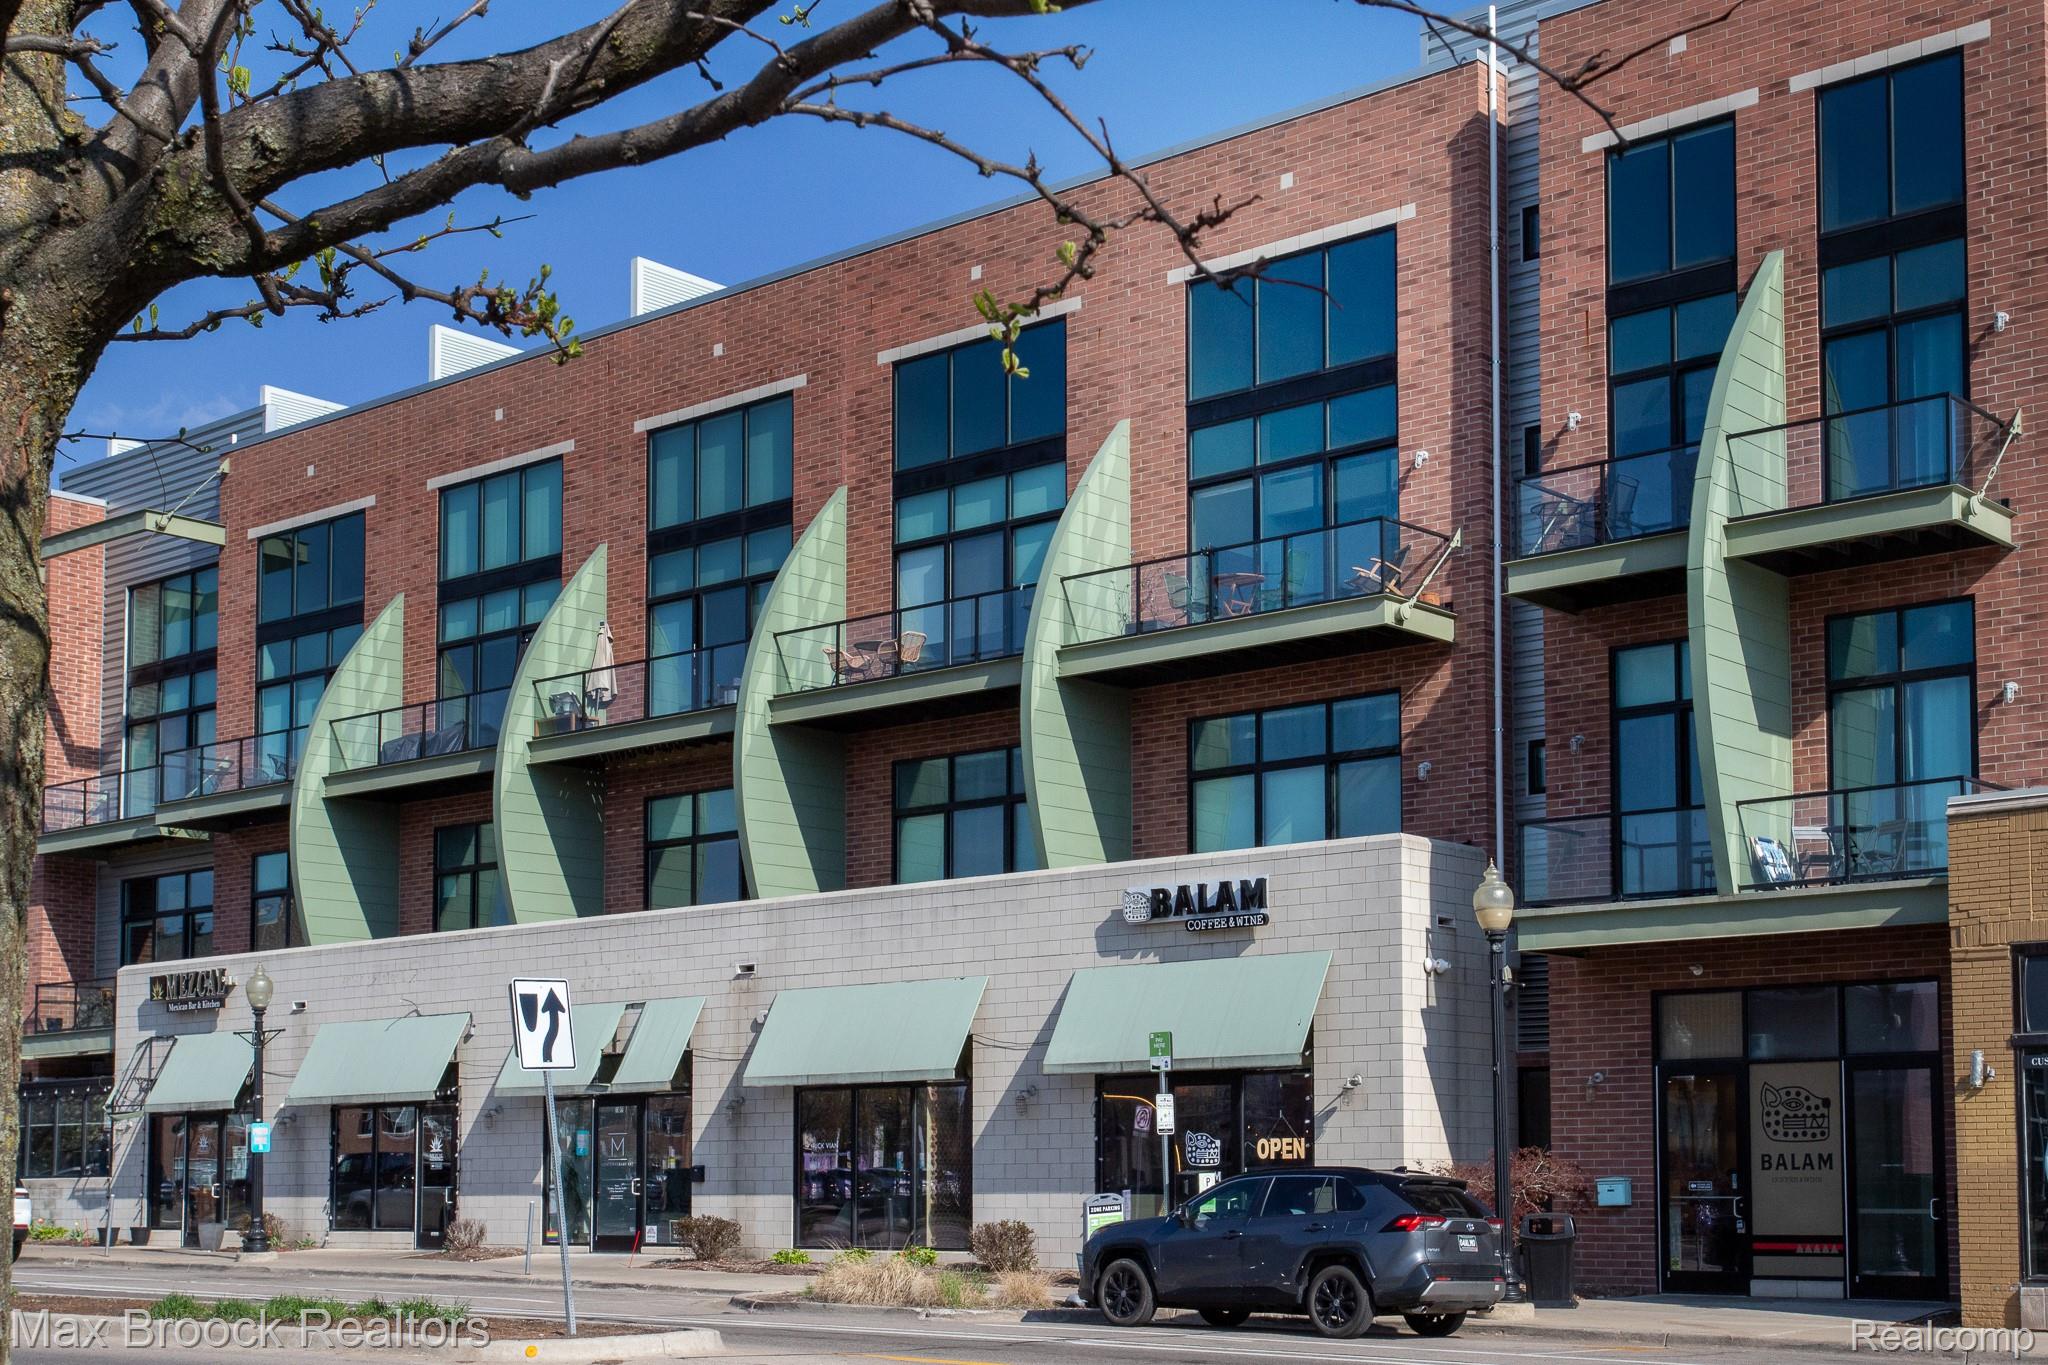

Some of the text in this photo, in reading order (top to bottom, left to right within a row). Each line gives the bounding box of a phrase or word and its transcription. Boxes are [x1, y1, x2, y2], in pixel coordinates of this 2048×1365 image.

[1150, 877, 1268, 918] BALAM
[1187, 917, 1227, 931] COFFEE
[1235, 914, 1264, 927] WINE
[166, 968, 226, 1000] MEZCAL
[168, 1003, 188, 1011] Mexican
[188, 1001, 197, 1010] Bar
[202, 1000, 220, 1009] Kitchen
[1256, 1137, 1305, 1160] OPEN
[1760, 1152, 1834, 1171] BALAM
[1102, 1204, 1121, 1212] PARKING
